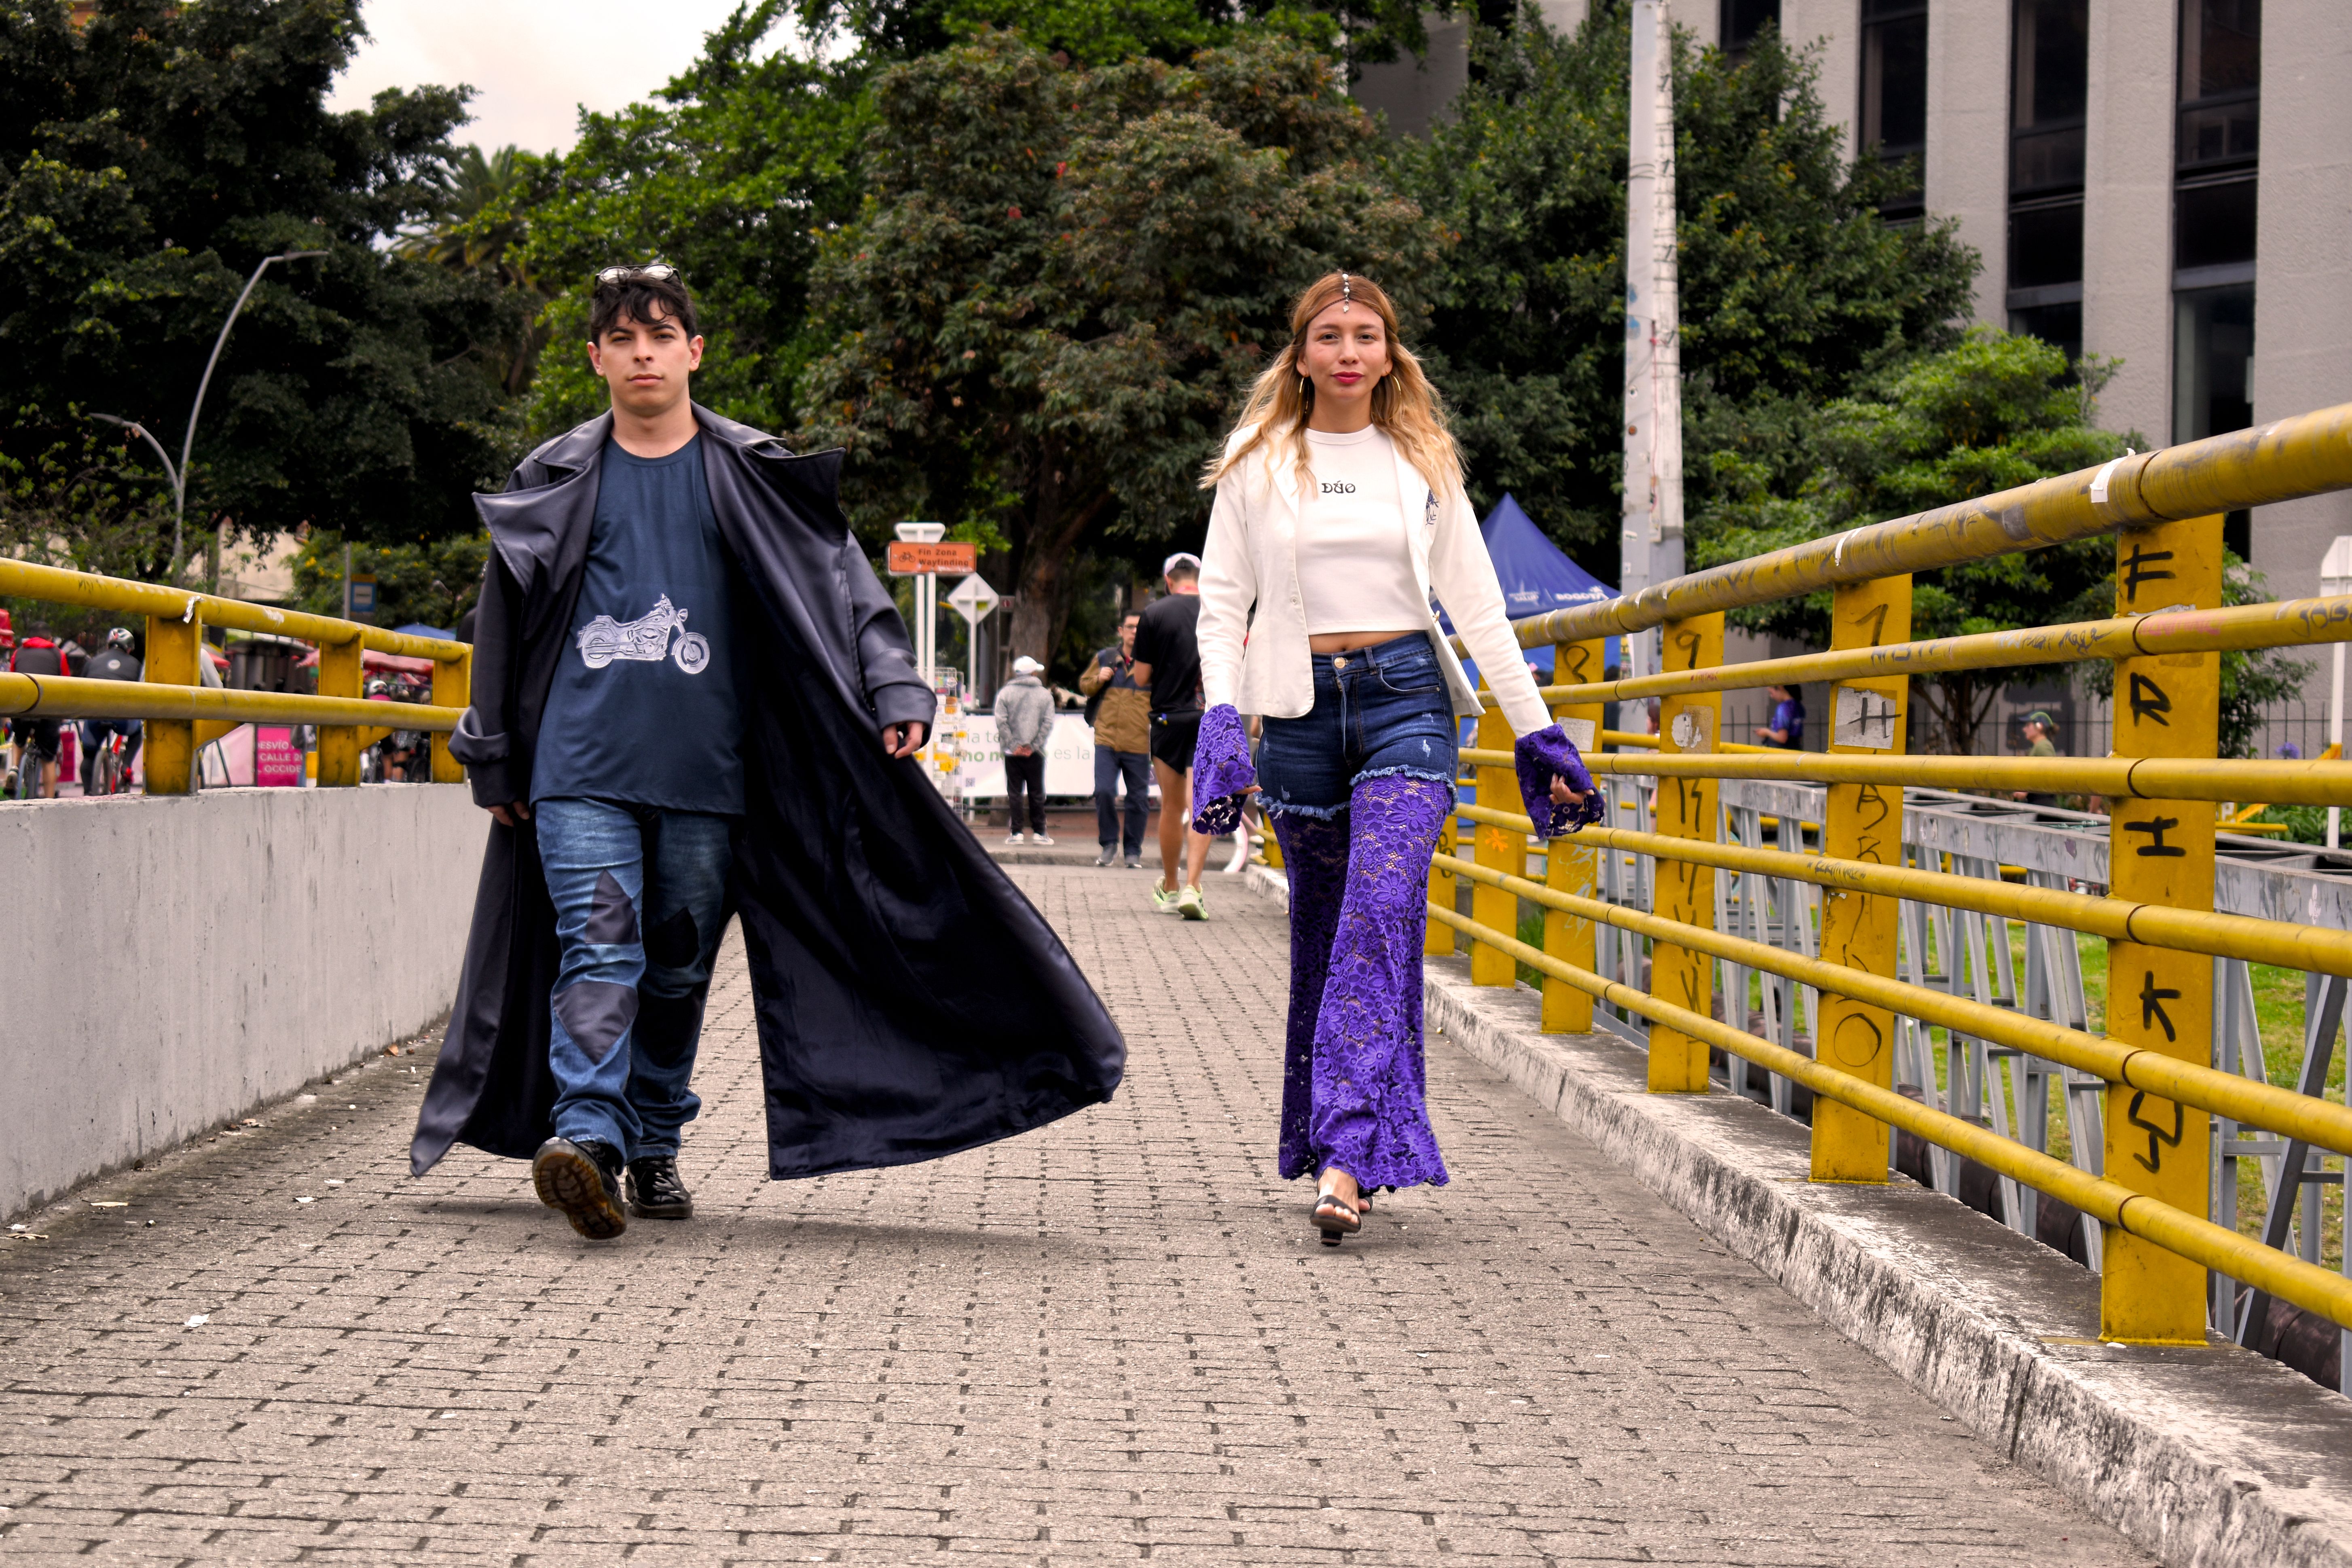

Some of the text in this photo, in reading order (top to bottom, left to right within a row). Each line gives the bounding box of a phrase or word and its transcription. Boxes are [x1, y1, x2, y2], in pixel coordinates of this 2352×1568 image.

[919, 559, 969, 567] Wayfinding
[260, 753, 291, 761] CALLE
[1054, 749, 1072, 760] es
